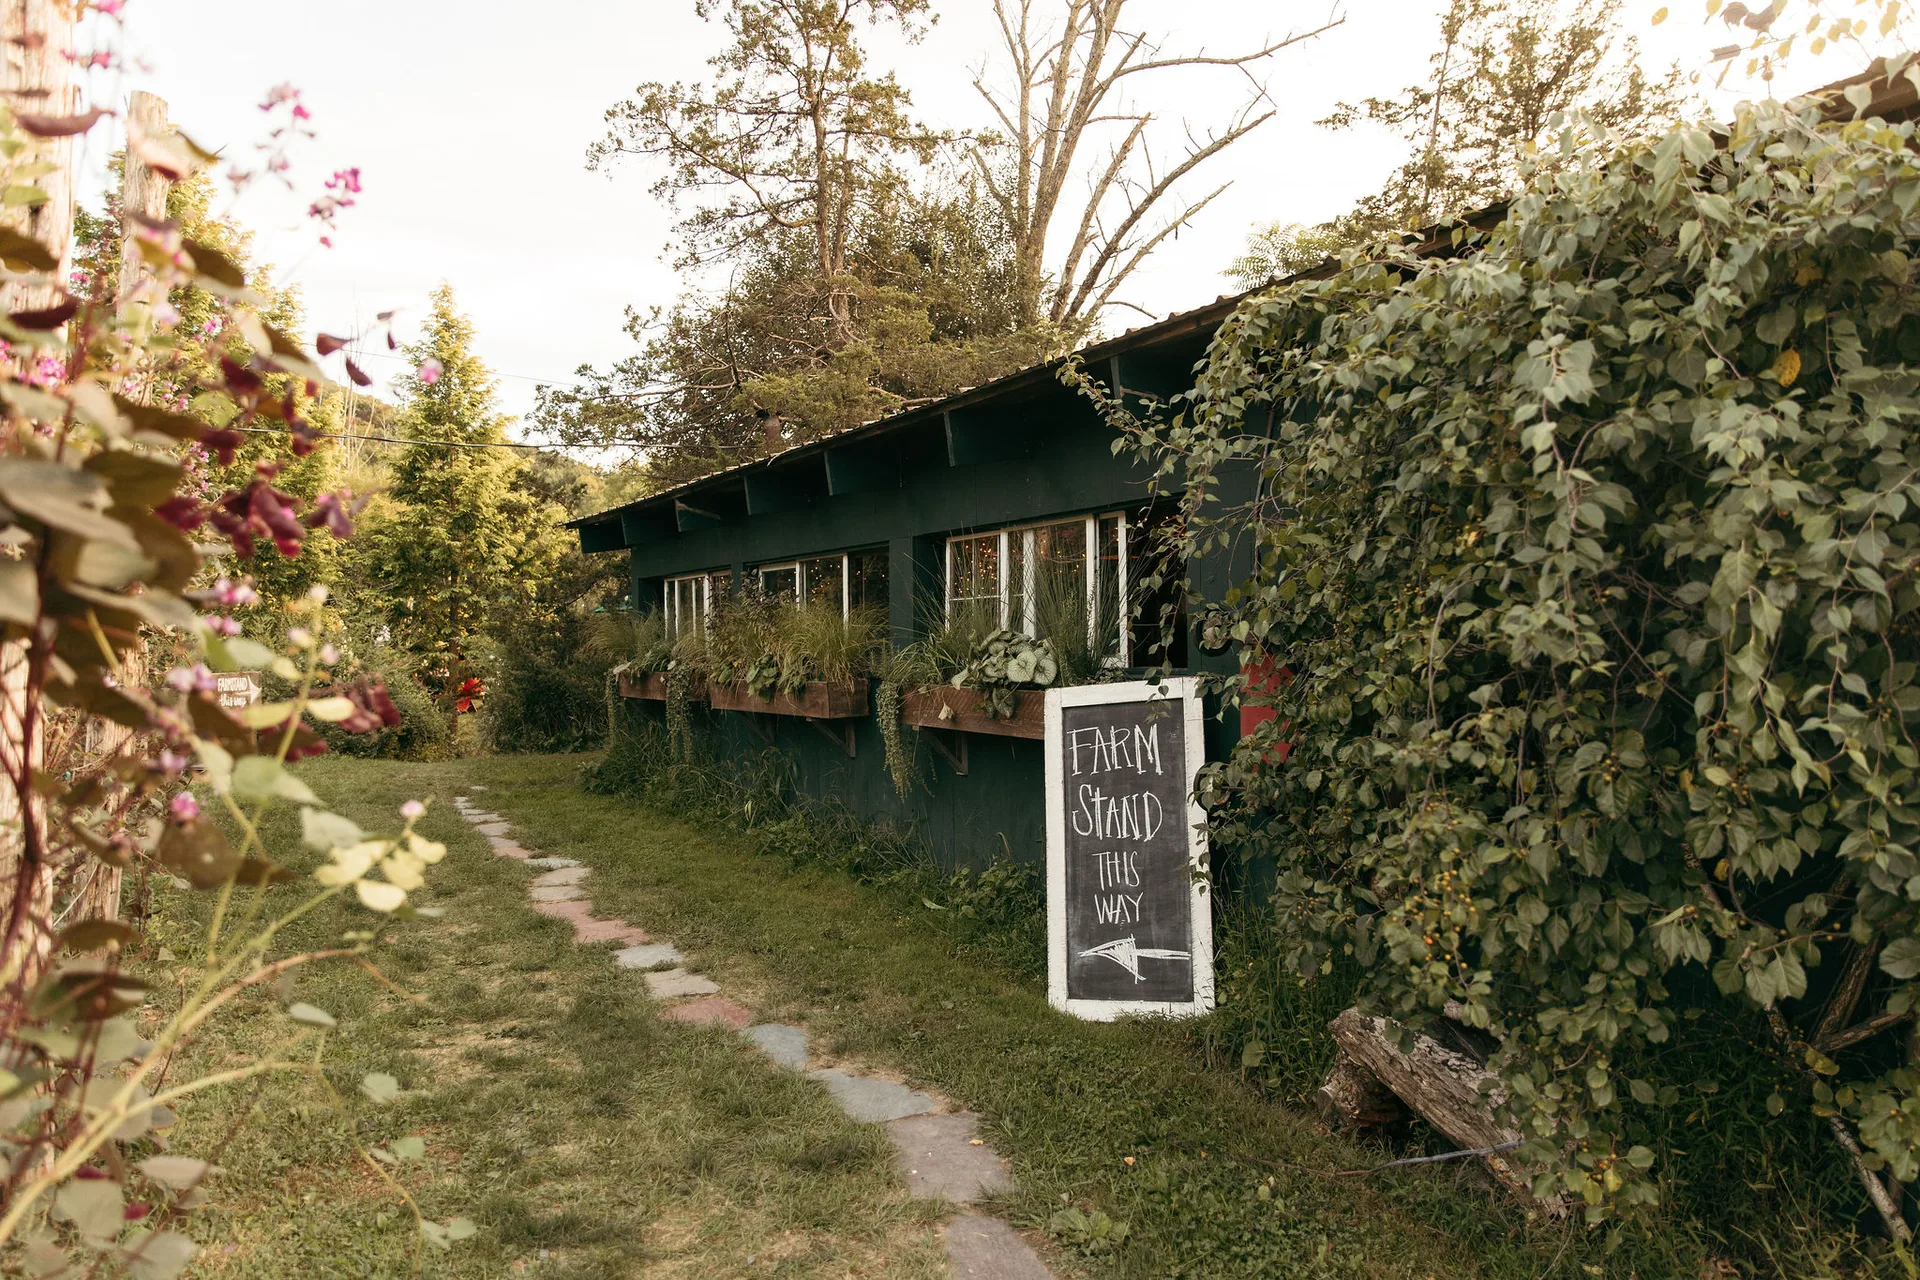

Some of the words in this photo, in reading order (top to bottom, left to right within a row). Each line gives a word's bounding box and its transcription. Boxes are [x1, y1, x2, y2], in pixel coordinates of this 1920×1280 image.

[219, 693, 233, 707] this
[1066, 723, 1164, 776] FARM
[1092, 851, 1140, 891] THIS
[1094, 892, 1144, 925] WAY
